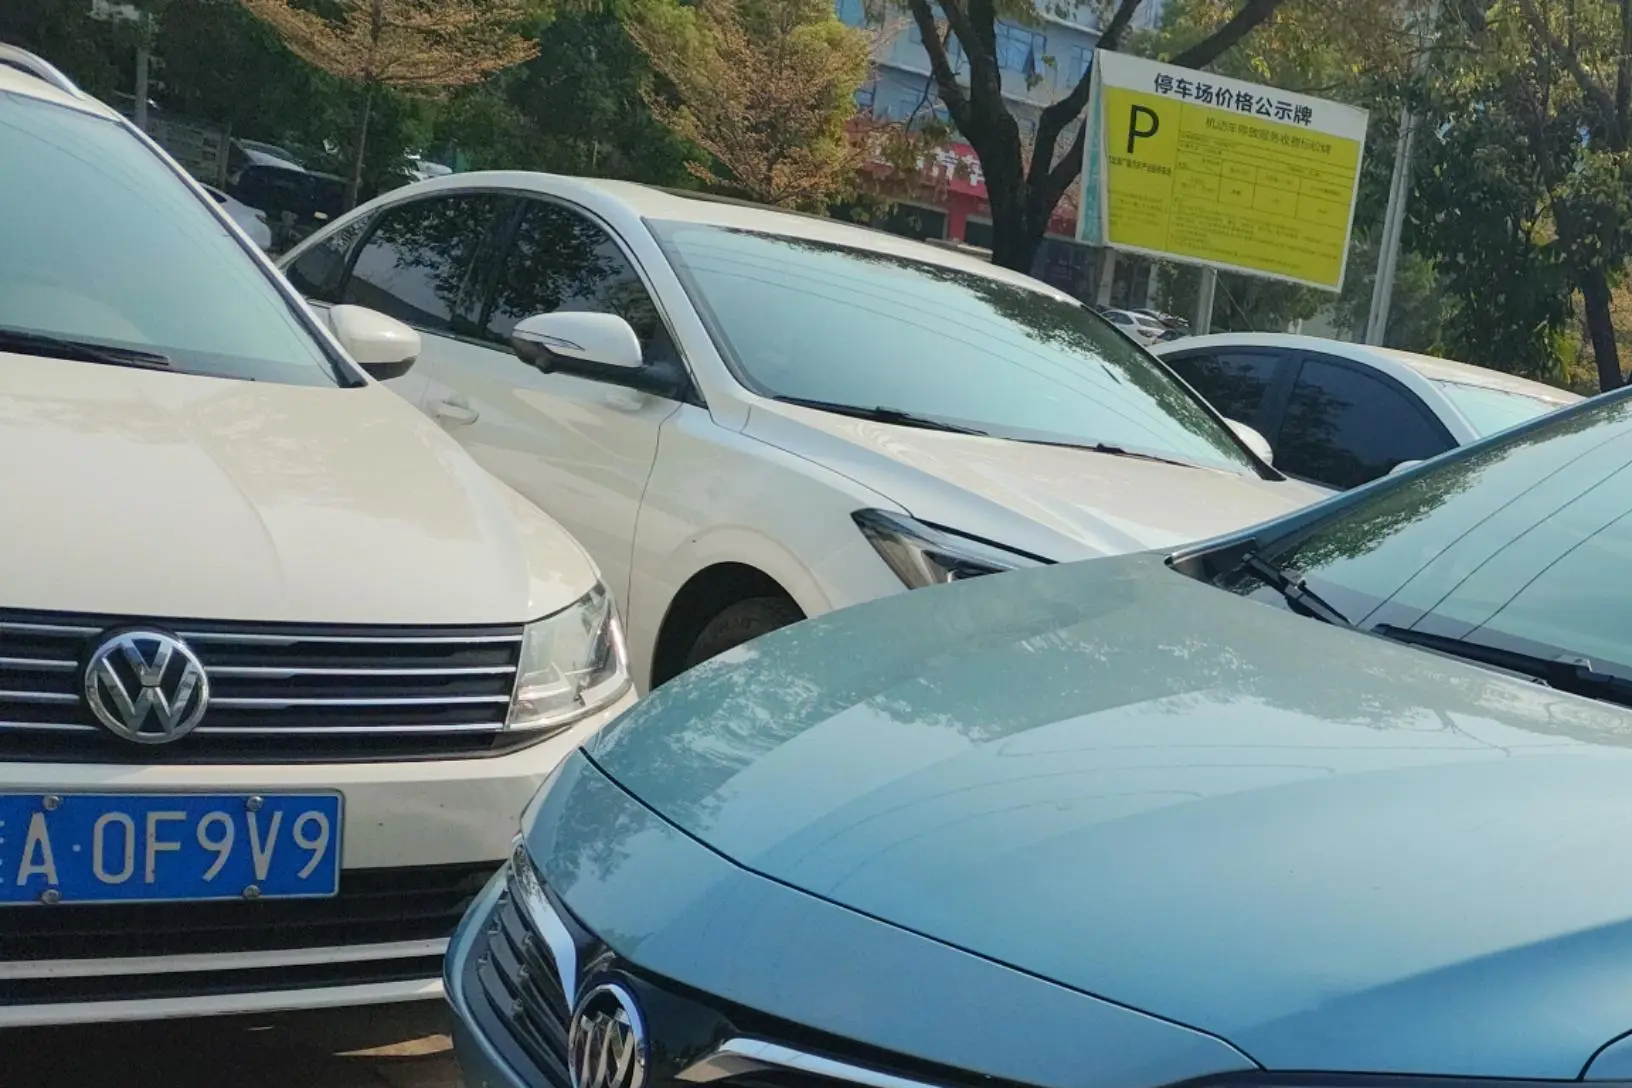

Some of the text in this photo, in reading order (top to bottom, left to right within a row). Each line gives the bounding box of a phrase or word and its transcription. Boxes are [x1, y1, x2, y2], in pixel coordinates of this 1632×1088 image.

[1154, 72, 1313, 126] 停车场价格公示牌
[1126, 104, 1160, 154] P
